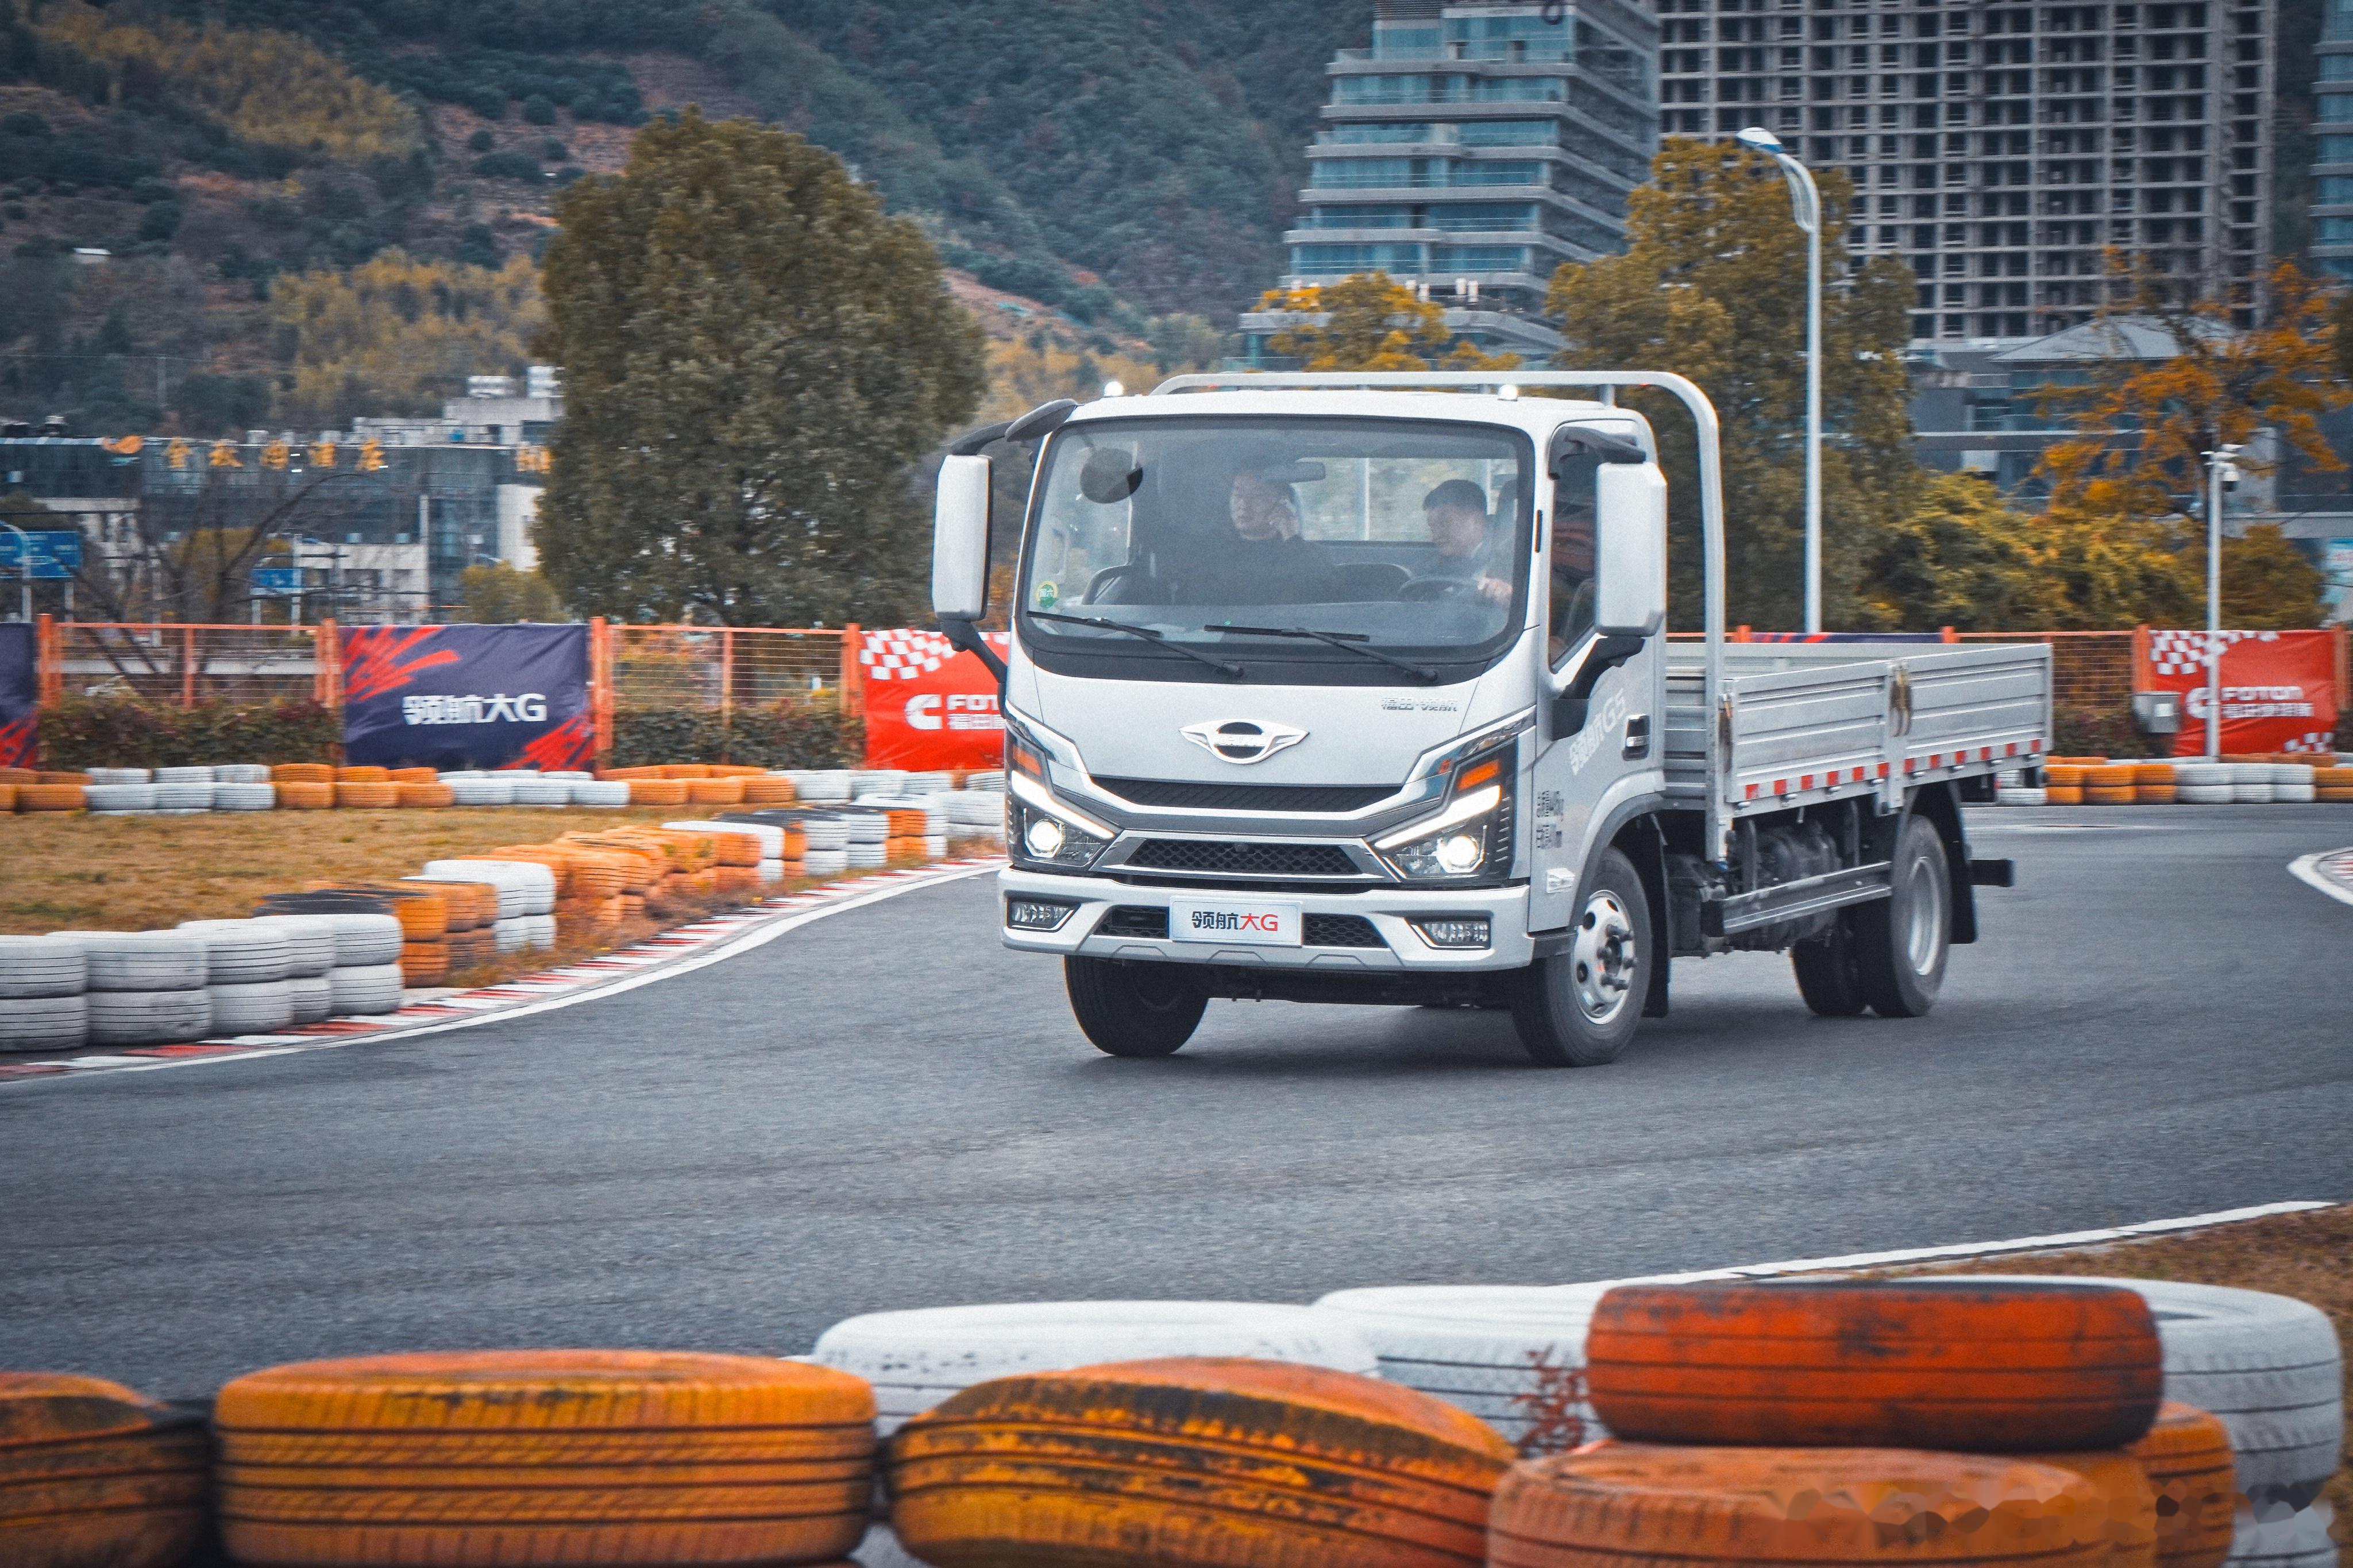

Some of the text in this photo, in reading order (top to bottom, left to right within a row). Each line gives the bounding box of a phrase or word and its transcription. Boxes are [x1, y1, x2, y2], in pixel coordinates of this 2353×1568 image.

[403, 693, 547, 725] 领航大G
[1191, 911, 1278, 932] 领航大G
